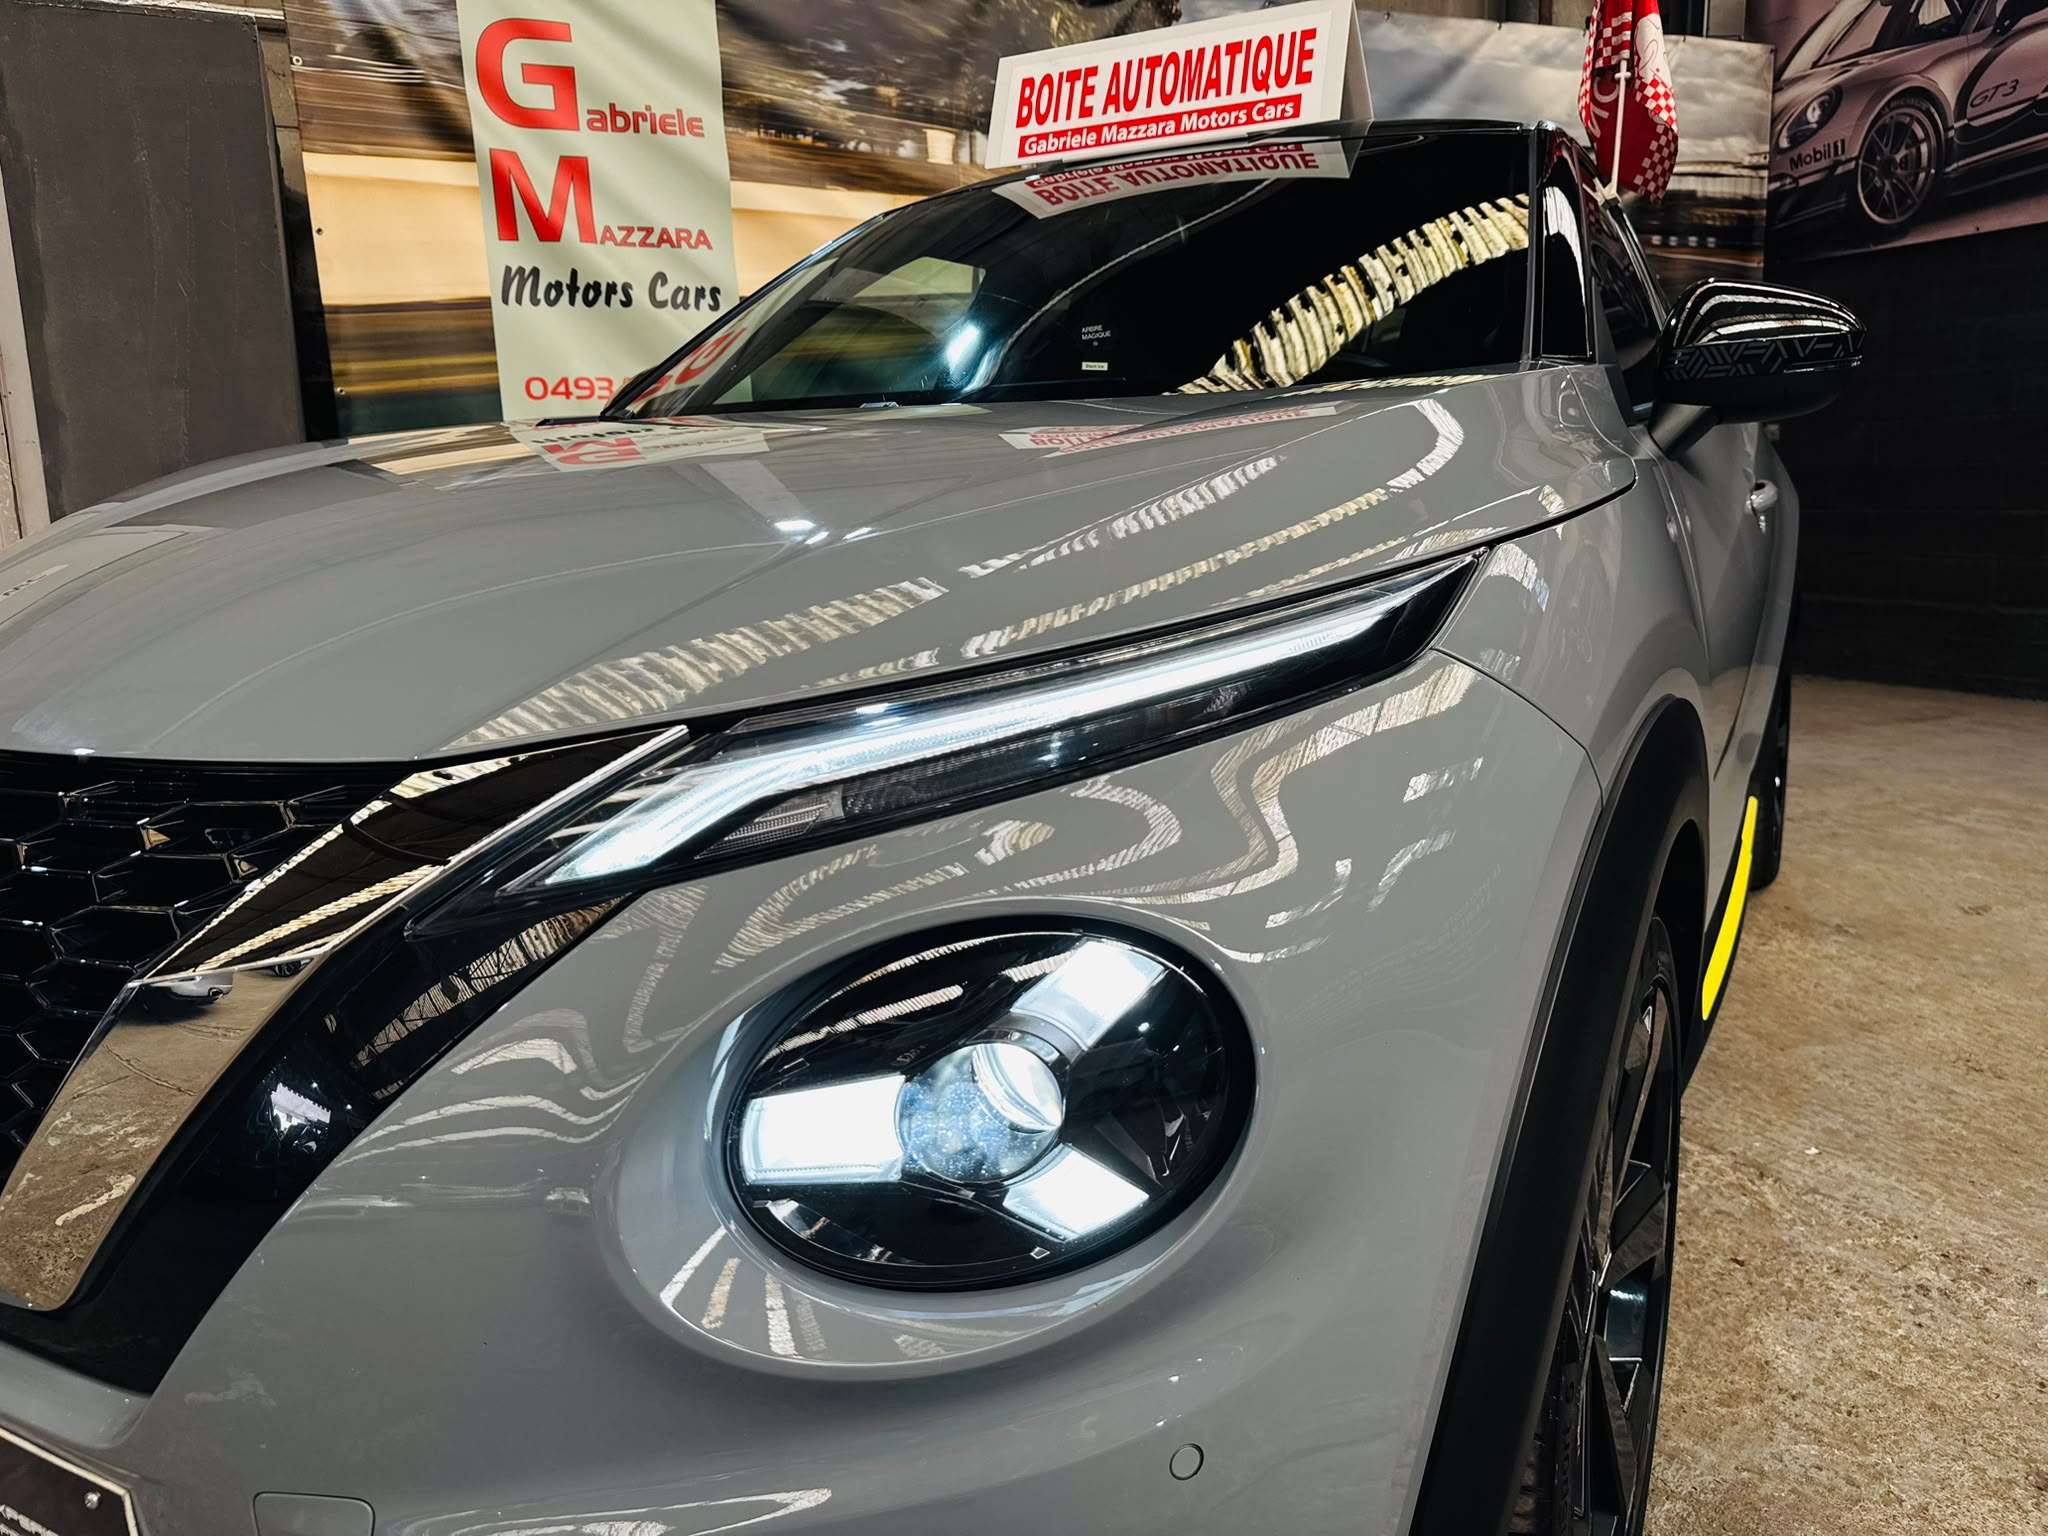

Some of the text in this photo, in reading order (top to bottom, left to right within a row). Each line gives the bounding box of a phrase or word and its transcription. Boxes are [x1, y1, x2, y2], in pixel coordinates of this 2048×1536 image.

[475, 18, 705, 138] Gabriele
[1016, 27, 1317, 129] BOITE AUTOMATIQUE
[1970, 78, 2019, 108] GT3
[1024, 98, 1295, 155] Gabriele Mazzara Motors Cars
[489, 148, 713, 250] MAZZARA
[502, 264, 721, 312] Motors Cars
[524, 376, 615, 401] 0493
